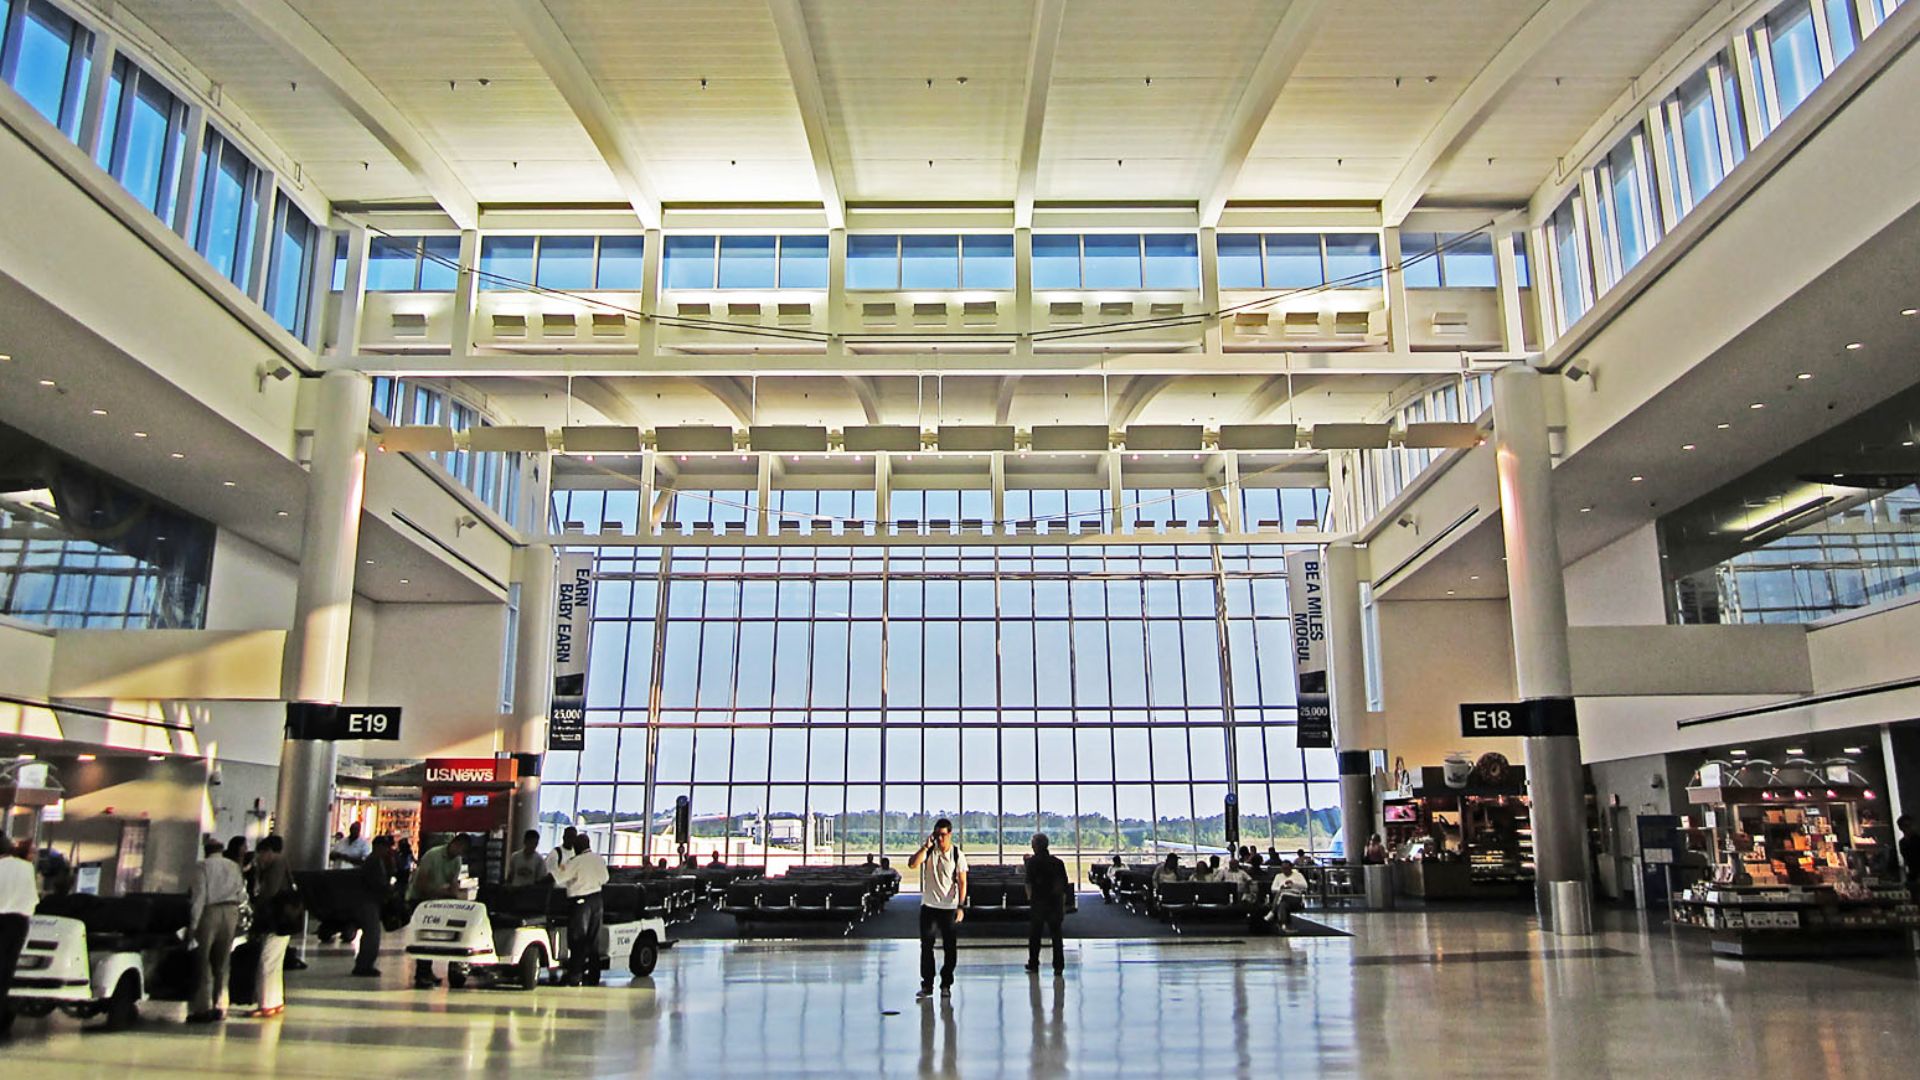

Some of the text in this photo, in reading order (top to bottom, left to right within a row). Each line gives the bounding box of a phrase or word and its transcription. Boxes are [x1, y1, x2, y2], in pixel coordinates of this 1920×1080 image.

[575, 568, 590, 607] EARN
[1304, 561, 1324, 641] BE A MILES
[556, 584, 574, 663] BABY EARN
[1294, 613, 1310, 665] MOGUL
[349, 713, 388, 733] E19
[1300, 706, 1328, 716] 25,000
[1473, 710, 1512, 729] E18
